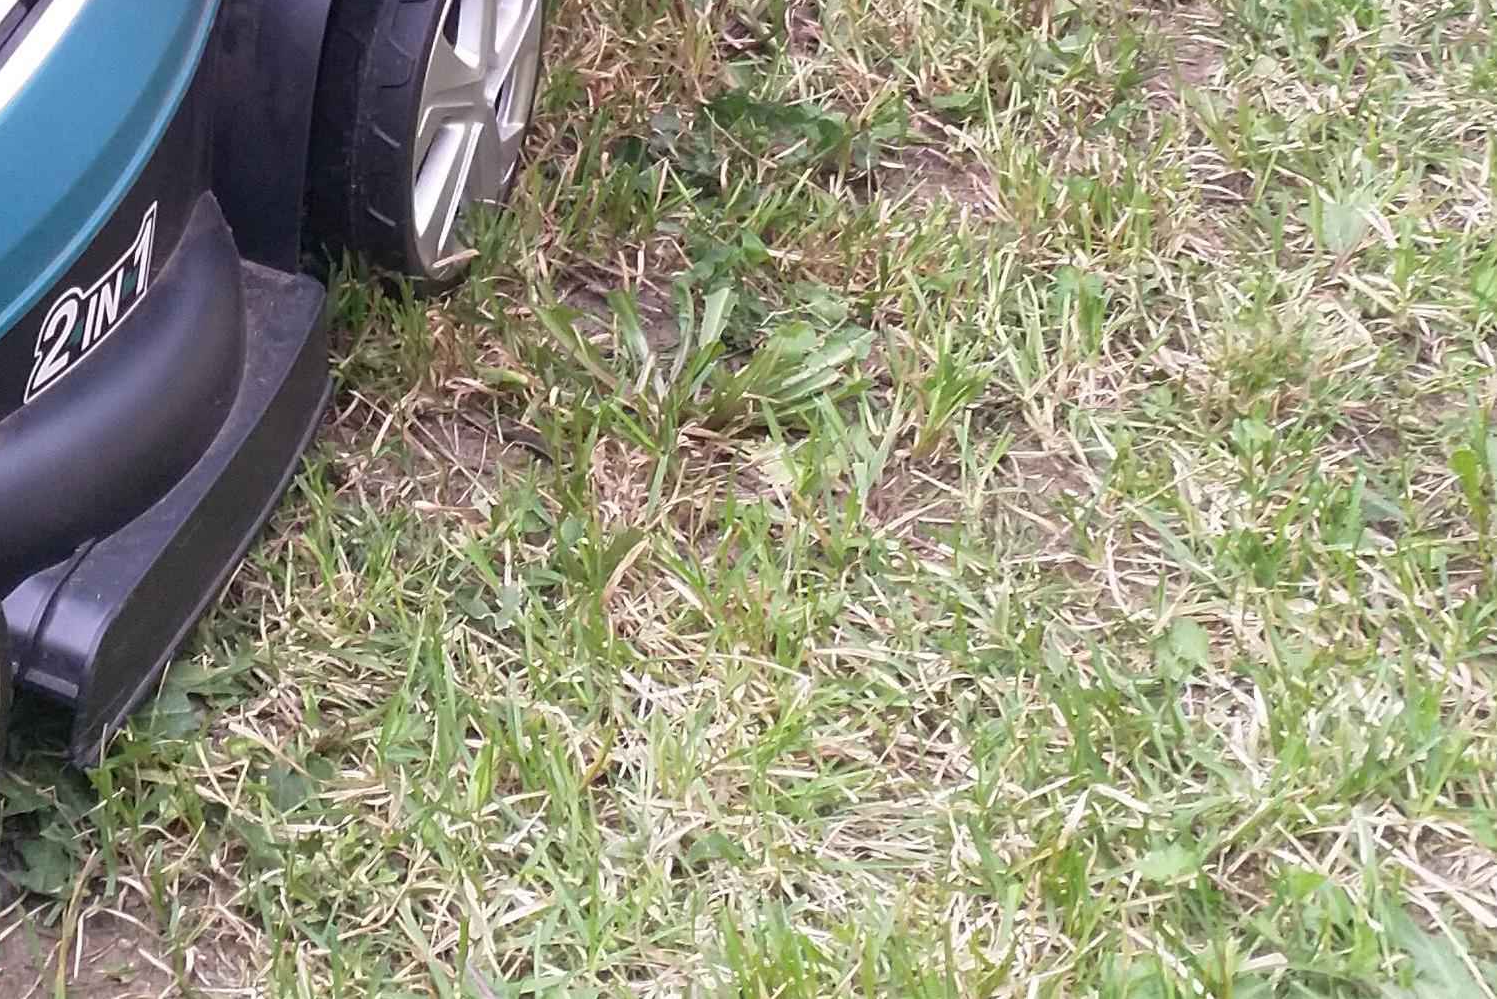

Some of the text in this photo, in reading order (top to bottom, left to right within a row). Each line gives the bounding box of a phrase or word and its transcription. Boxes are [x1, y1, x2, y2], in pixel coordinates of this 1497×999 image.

[32, 217, 153, 390] 2 IN 1
